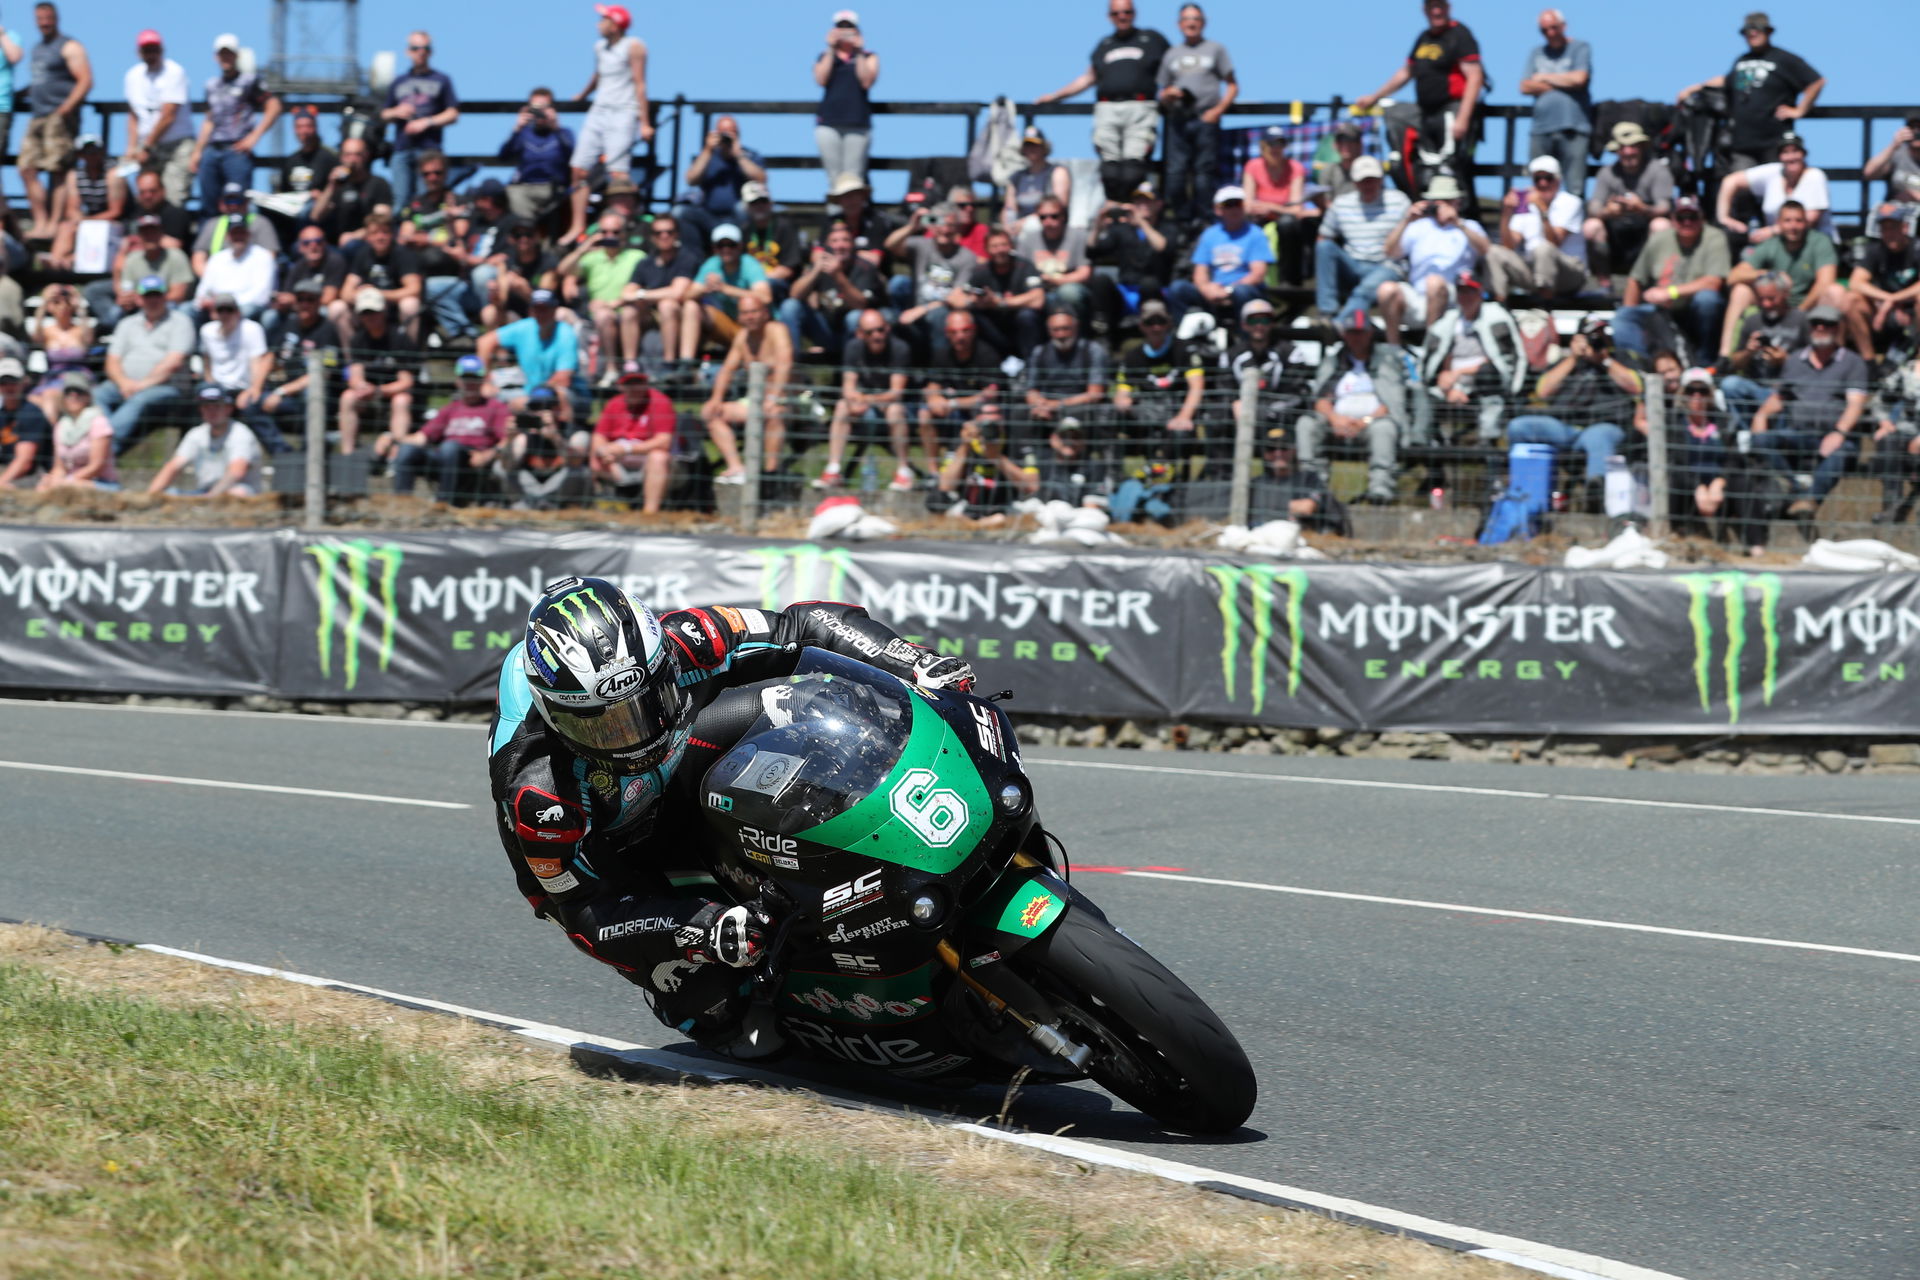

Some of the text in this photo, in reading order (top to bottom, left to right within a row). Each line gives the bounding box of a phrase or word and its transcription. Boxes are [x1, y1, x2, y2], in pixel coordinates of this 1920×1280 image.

[0, 558, 263, 613] MONSTER
[859, 574, 1160, 634] MONSTER
[25, 618, 222, 643] ENERGY
[1318, 596, 1626, 649] MONSTER
[600, 669, 640, 697] Arai
[1365, 659, 1579, 681] ENERGY
[968, 702, 994, 755] SC
[889, 768, 970, 848] 6
[823, 868, 882, 908] SC
[847, 917, 892, 939] SPRINT
[863, 919, 910, 939] FILTER
[831, 952, 880, 968] SC
